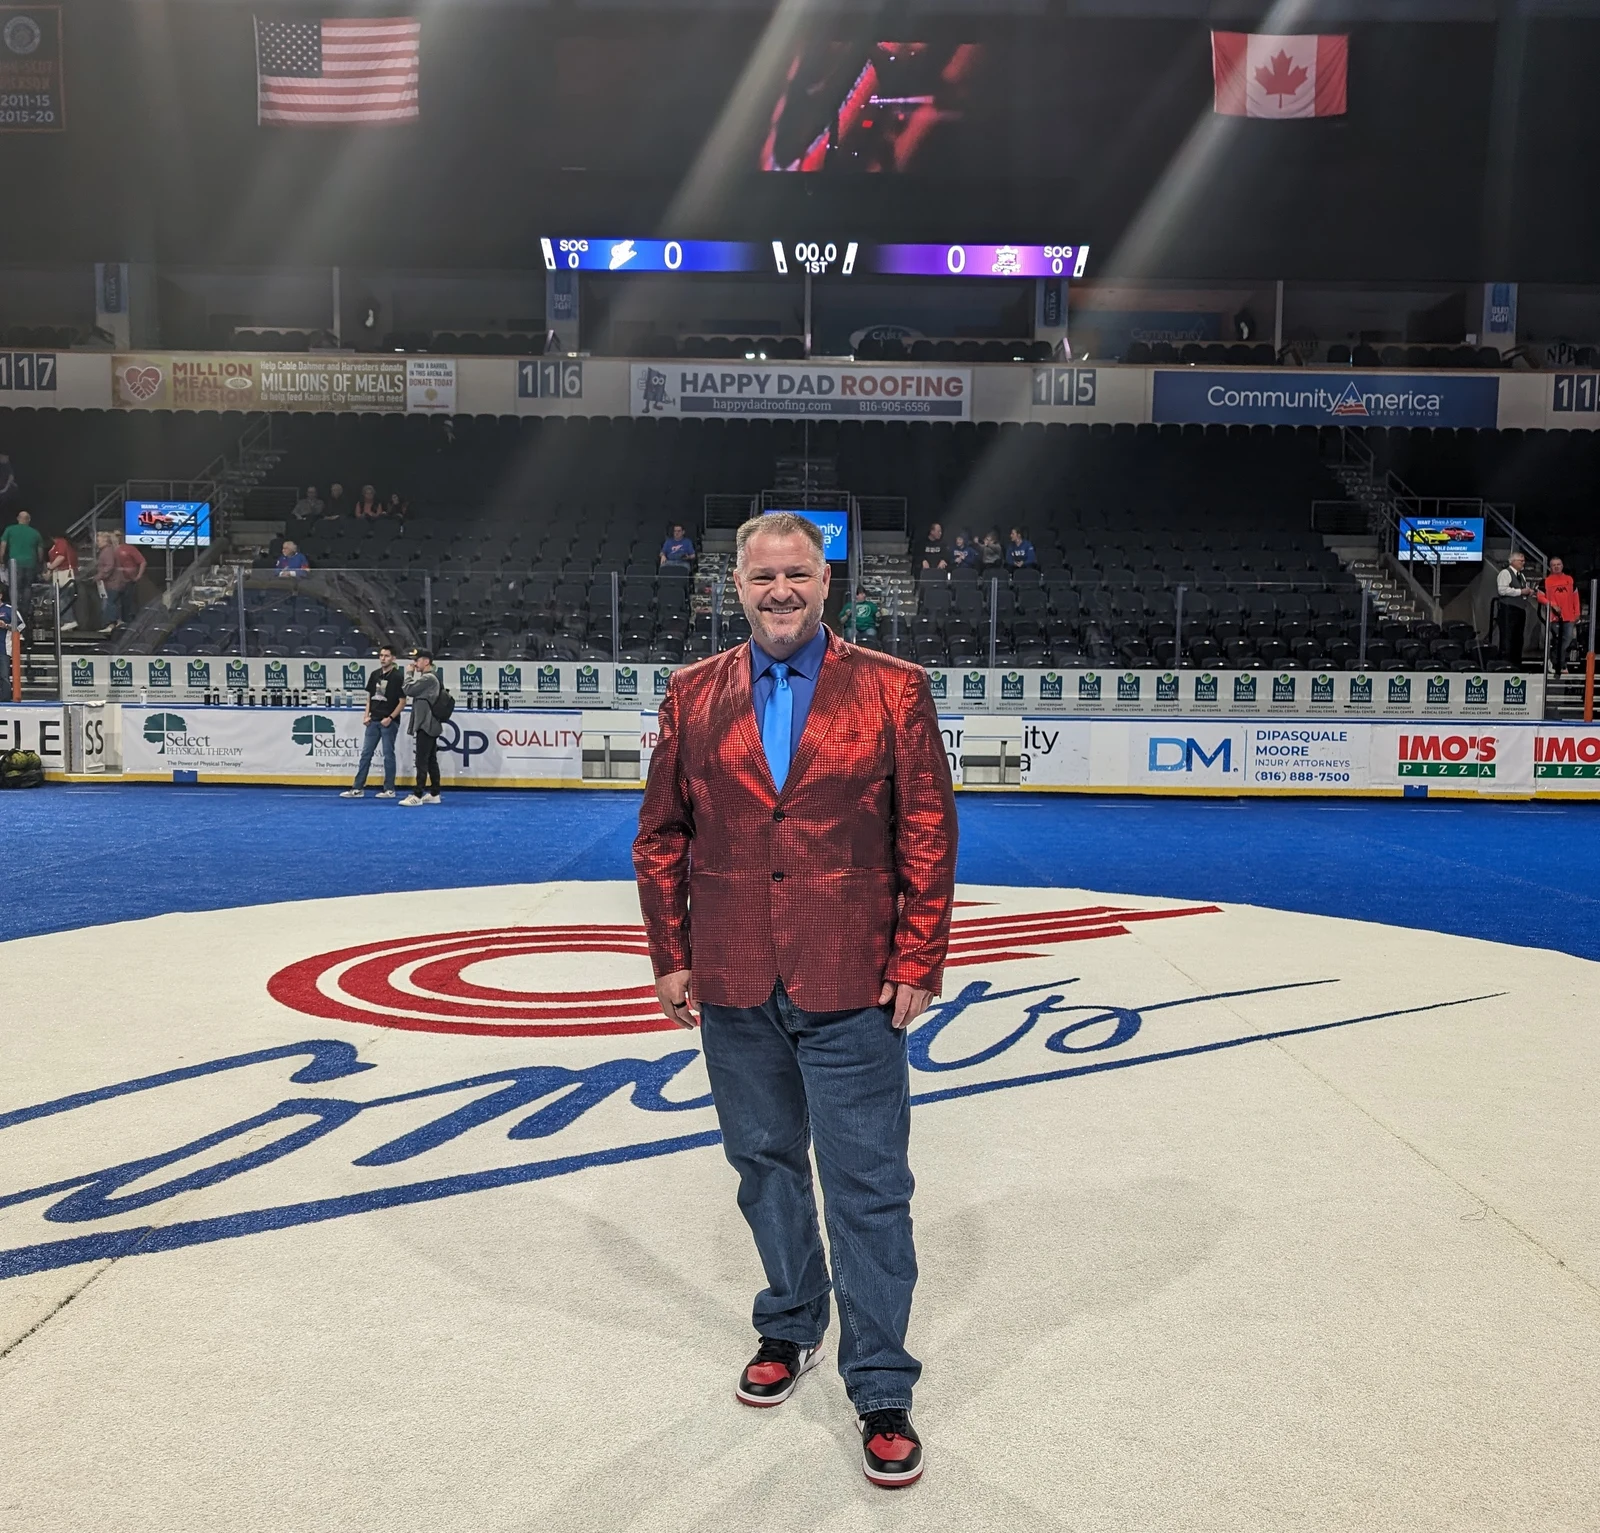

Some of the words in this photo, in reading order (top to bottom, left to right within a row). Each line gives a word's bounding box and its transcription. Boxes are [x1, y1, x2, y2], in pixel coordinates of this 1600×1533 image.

[0, 94, 50, 106] 2011-15
[0, 110, 54, 122] 2015-20
[560, 240, 588, 251] SOG
[1044, 246, 1072, 258] SOG
[664, 242, 682, 269] 0
[795, 243, 837, 262] 00.0
[947, 245, 966, 273] 0
[568, 252, 580, 268] 0
[1052, 258, 1063, 274] 0
[804, 262, 828, 273] 1ST
[173, 363, 252, 376] MILLION
[260, 361, 276, 370] Help
[278, 361, 296, 370] Cable
[328, 362, 340, 370] and
[342, 362, 379, 372] Harvesters
[380, 363, 404, 372] donate
[173, 376, 222, 389] MEAL
[261, 373, 328, 392] MILLIONS
[334, 374, 352, 392] OF
[356, 374, 404, 392] MEALS
[522, 365, 580, 394] 116
[681, 372, 771, 394] HAPPY
[777, 374, 835, 396] DAD
[840, 375, 964, 398] ROOFING
[1036, 372, 1094, 402] 115
[1558, 379, 1600, 408] 11
[173, 390, 252, 403] MISSION
[270, 393, 286, 402] help
[332, 394, 346, 403] City
[347, 394, 376, 402] families
[386, 394, 404, 402] need
[712, 399, 832, 412] happydadroofing.com
[860, 402, 930, 412] 816-905-6556
[166, 732, 211, 747] Select
[314, 734, 360, 749] Select
[496, 730, 582, 748] QUALITY
[1256, 730, 1348, 742] DIPASQUALE
[166, 748, 206, 756] PHYSICAL
[206, 748, 244, 756] THERAPY
[1256, 745, 1310, 756] MOORE
[1398, 735, 1496, 762] IMO'S
[1255, 759, 1290, 767] INJURY
[1293, 759, 1351, 768] ATTORNEYS
[1402, 764, 1492, 776] PIZZA
[1255, 772, 1287, 782] (816)
[1290, 772, 1350, 782] 888-7500
